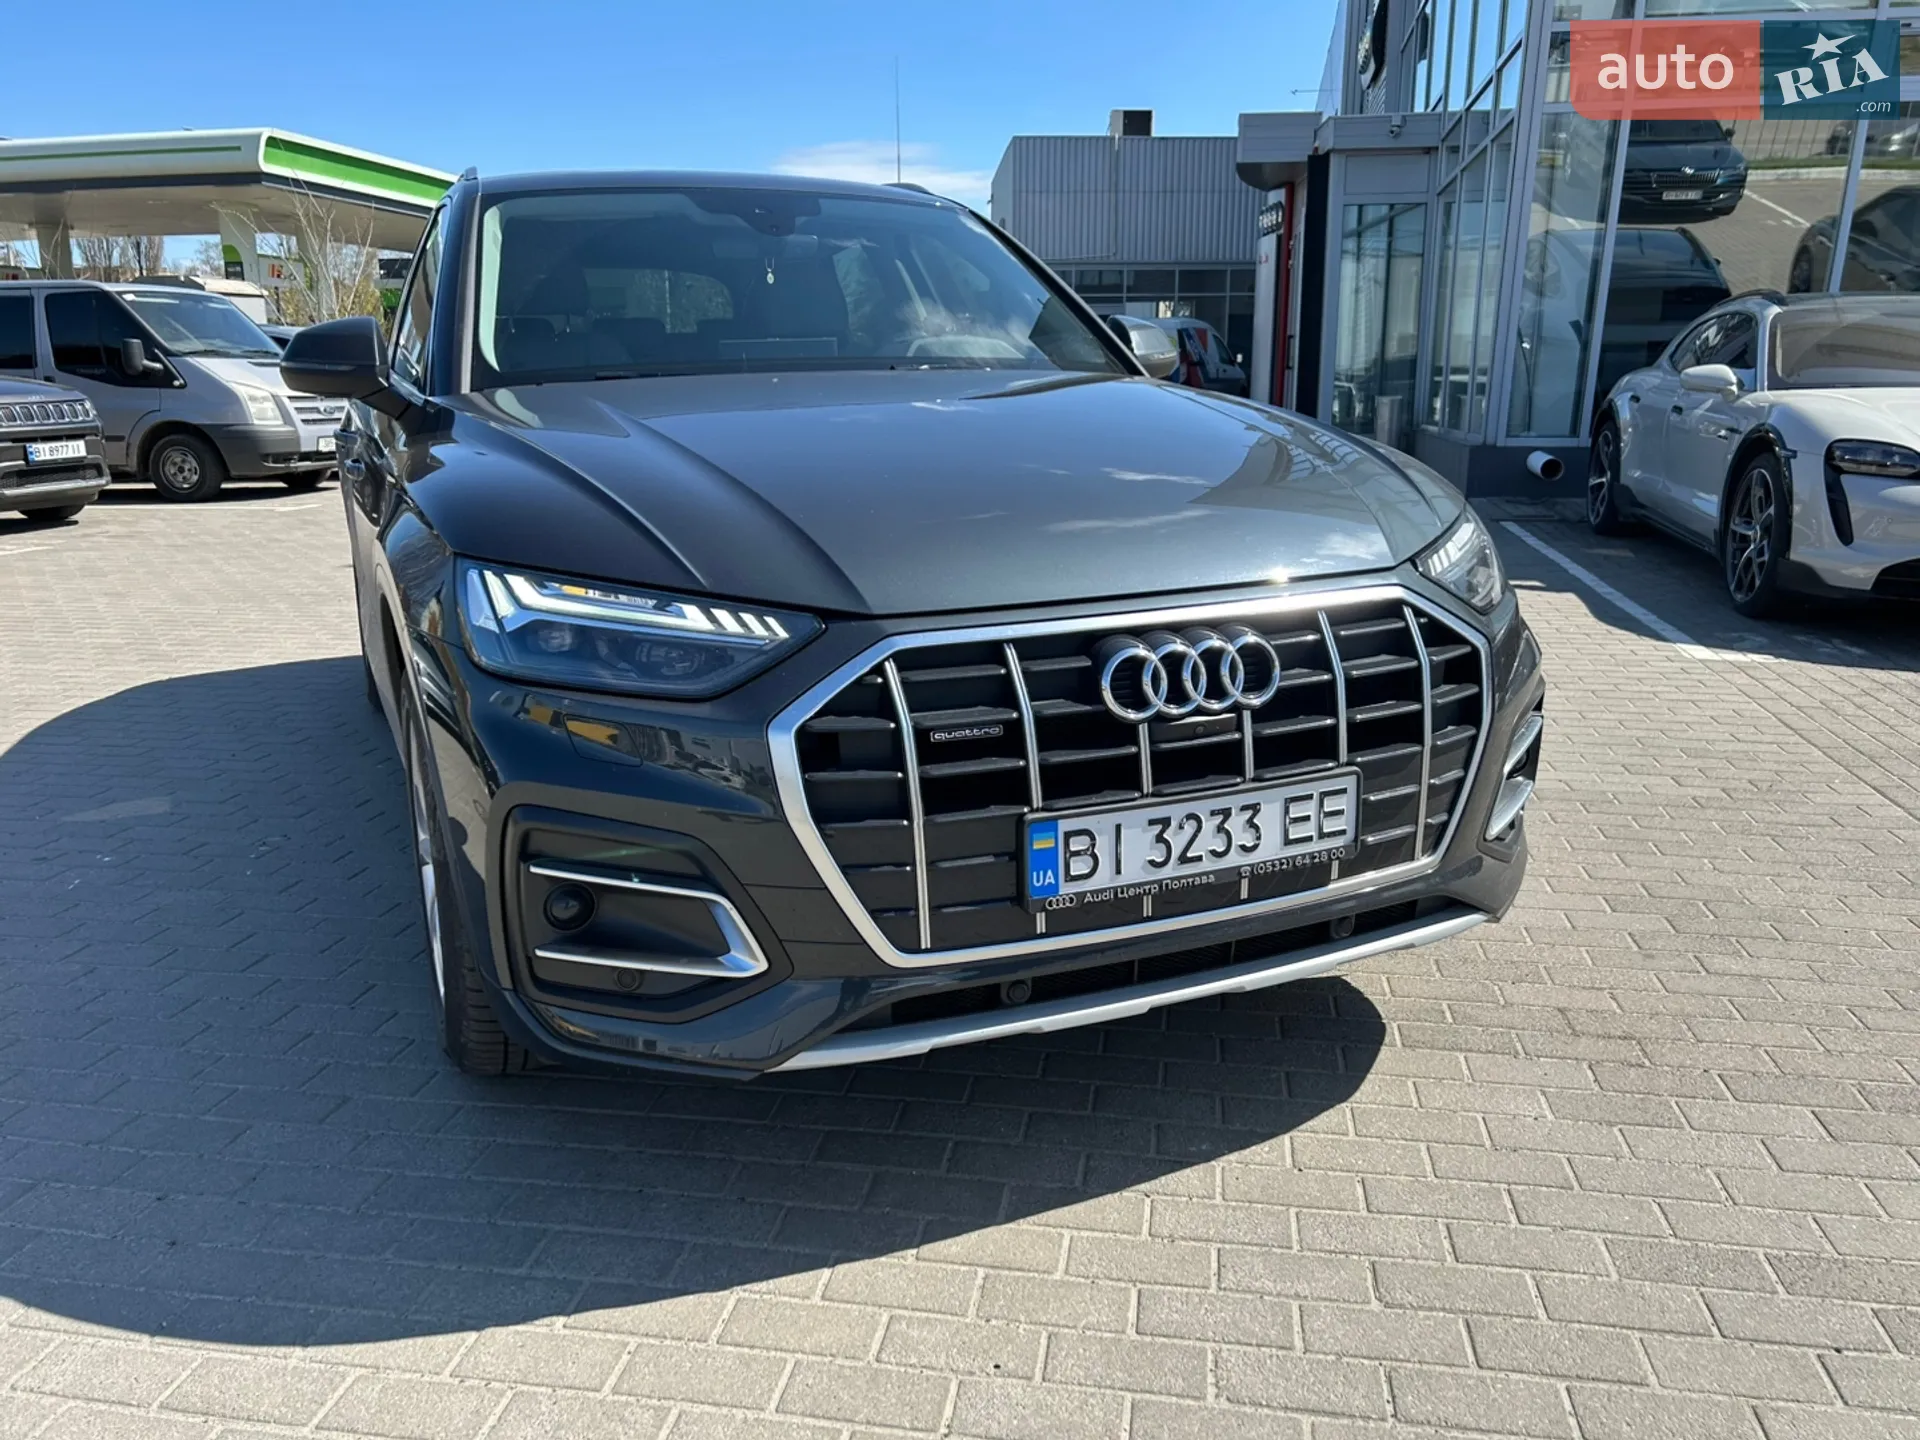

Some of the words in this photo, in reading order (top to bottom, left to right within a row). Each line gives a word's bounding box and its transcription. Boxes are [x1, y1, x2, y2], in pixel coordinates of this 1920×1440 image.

[934, 727, 1000, 740] quattro
[1063, 822, 1123, 883] BI
[1147, 802, 1263, 869] 3233
[1283, 787, 1348, 848] EE
[1032, 871, 1056, 887] UA
[1083, 891, 1114, 904] Audi
[1118, 884, 1159, 900] Центр
[1162, 873, 1215, 891] Полтава
[1254, 859, 1292, 876] (0532)
[1295, 855, 1311, 868] 64
[1313, 851, 1328, 864] 28
[1331, 847, 1345, 860] 00
